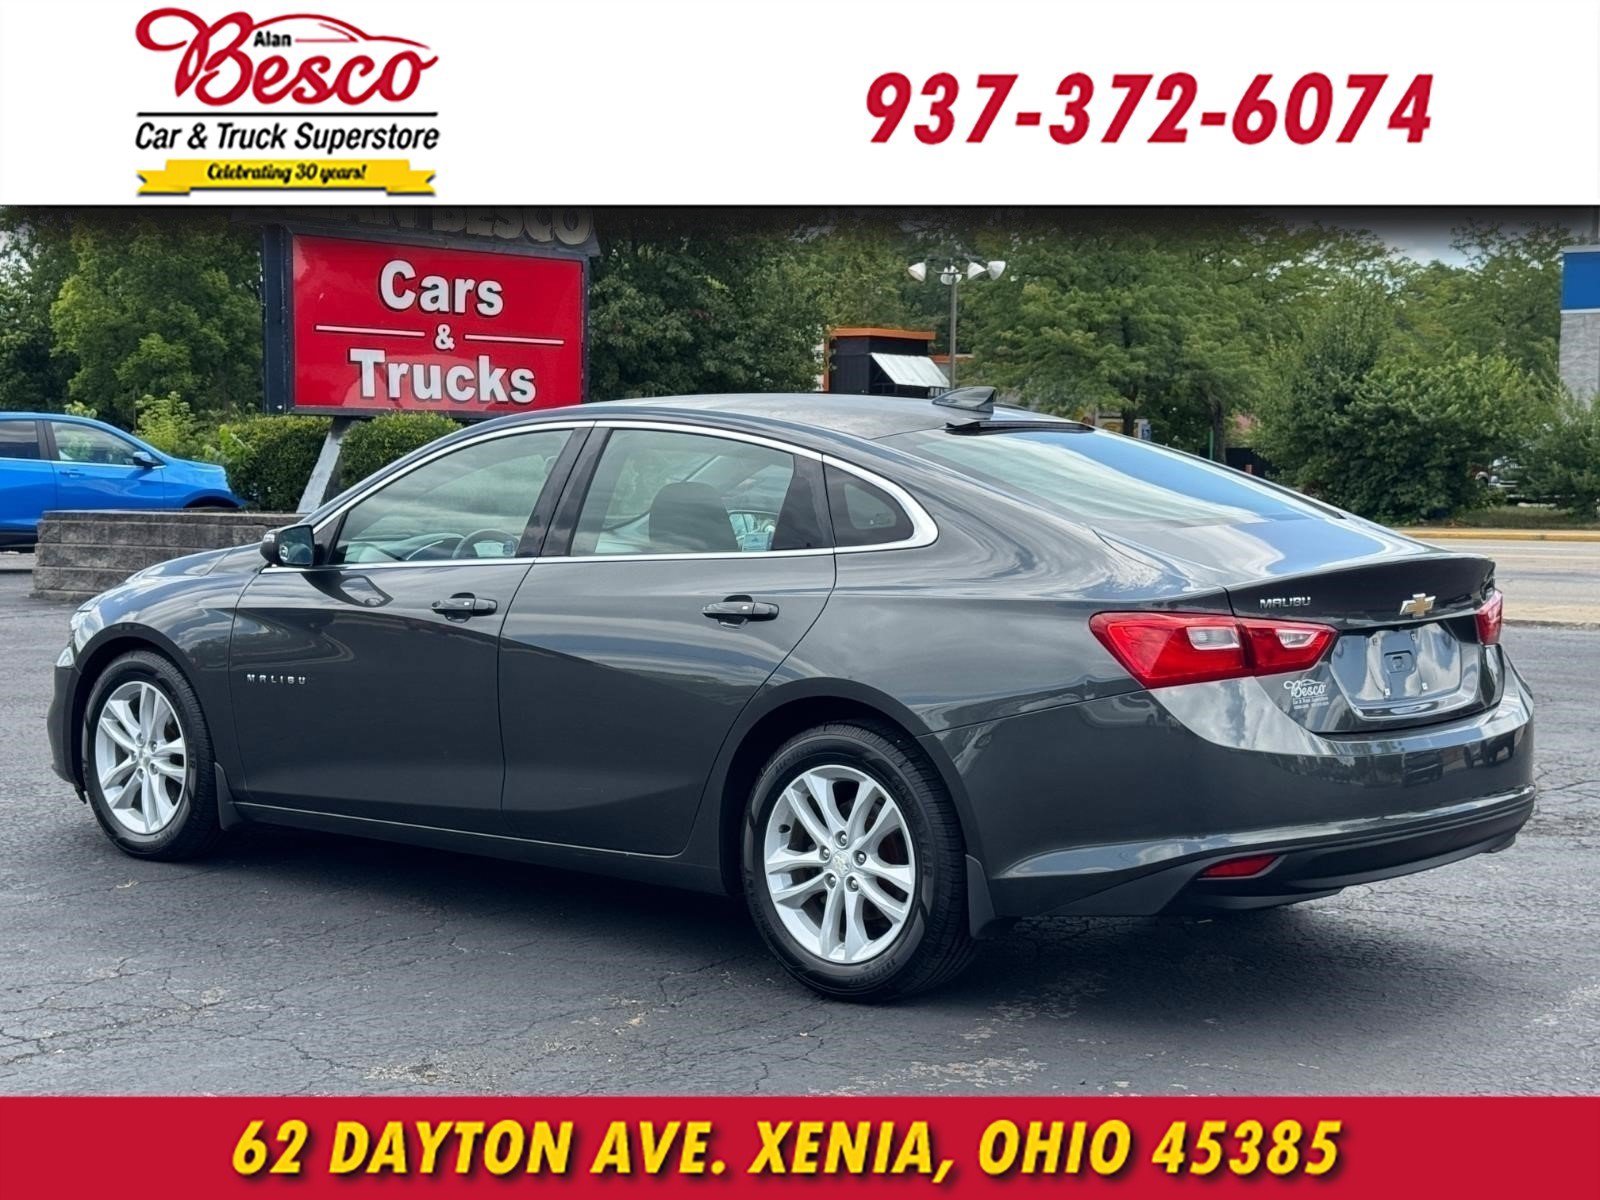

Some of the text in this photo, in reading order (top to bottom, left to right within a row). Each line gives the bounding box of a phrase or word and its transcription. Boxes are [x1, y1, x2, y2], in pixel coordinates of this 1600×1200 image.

[380, 260, 503, 316] Cars
[434, 324, 455, 350] &
[350, 347, 536, 404] Trucks
[1260, 597, 1311, 609] MALIBU
[246, 673, 306, 685] MALIBU
[1284, 680, 1327, 698] Besco
